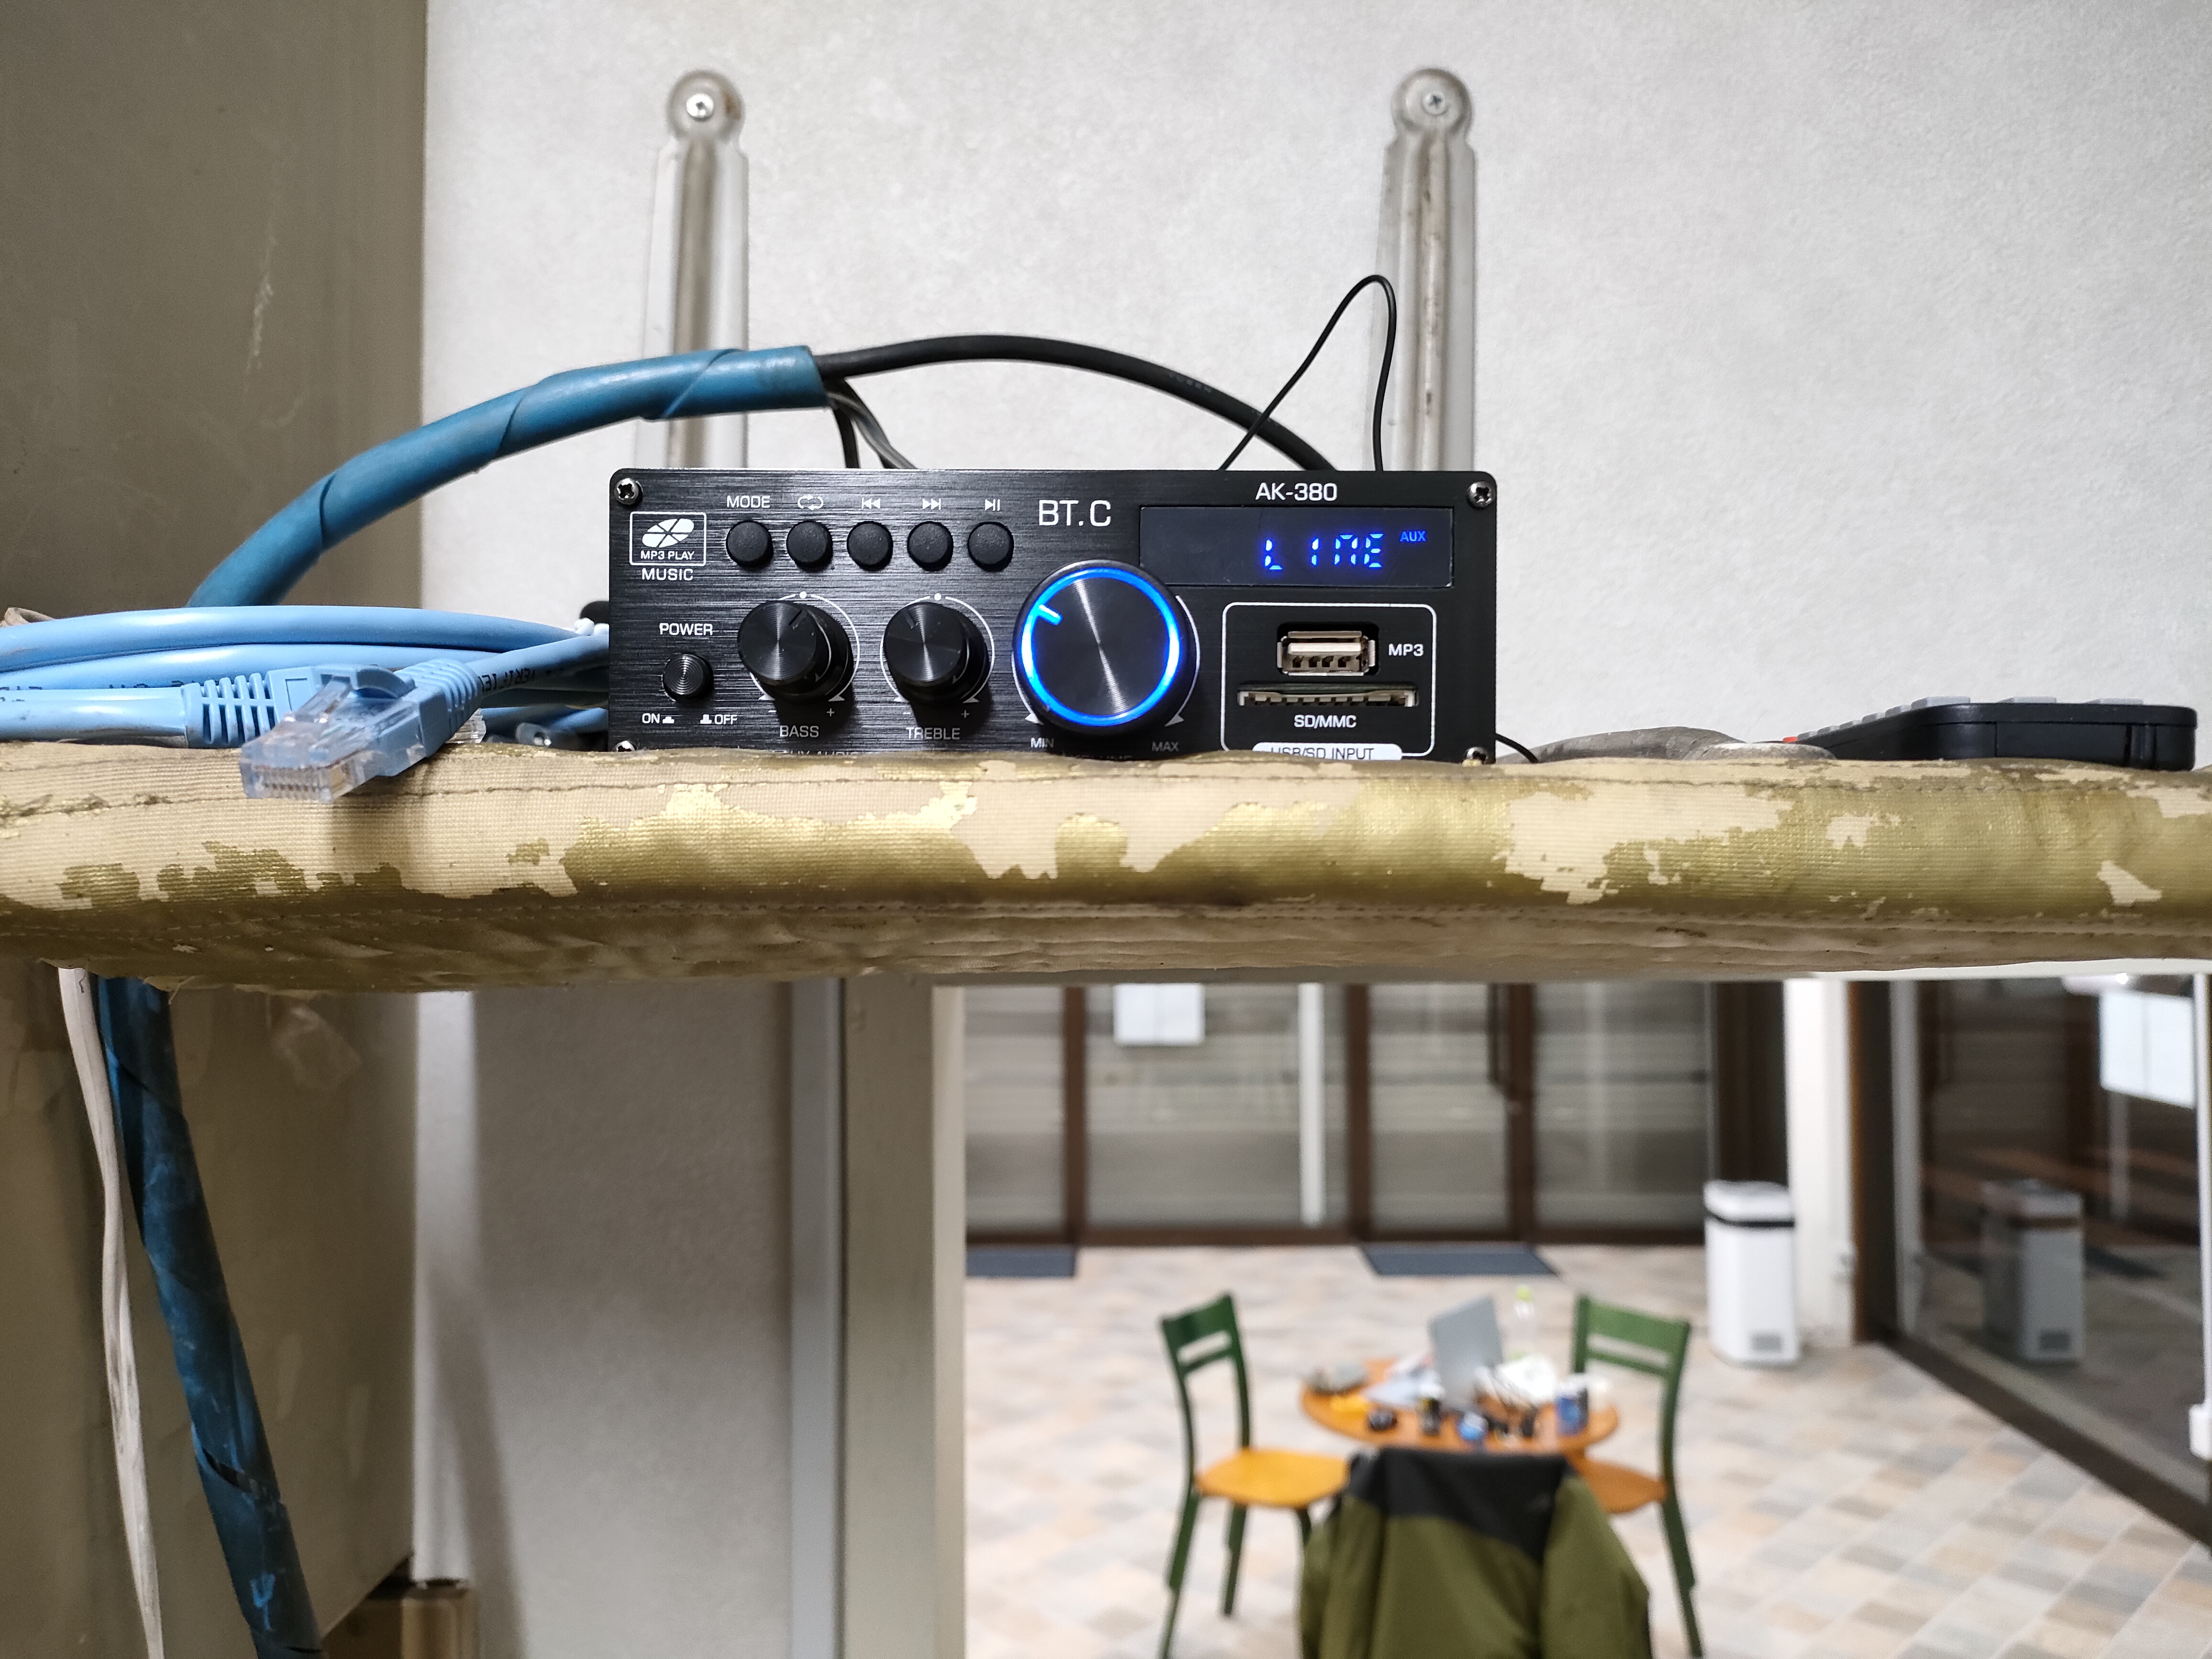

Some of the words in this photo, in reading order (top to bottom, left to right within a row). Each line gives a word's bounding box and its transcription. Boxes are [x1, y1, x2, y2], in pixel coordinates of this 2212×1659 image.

[1255, 483, 1338, 501] AK-380
[726, 496, 771, 509] MODE
[1038, 499, 1111, 527] BT.C
[1400, 531, 1427, 542] AUX
[640, 551, 665, 561] MP3
[667, 551, 695, 561] PLAY
[641, 568, 694, 581] MUSIC
[659, 623, 713, 636] POWER
[1388, 643, 1424, 656] MP3
[642, 713, 660, 724] ON
[714, 714, 738, 725] OFF
[1294, 715, 1357, 729] SD/MMC
[779, 725, 819, 738] BASS
[906, 727, 961, 740] TREBLE
[1030, 737, 1054, 748] MIN
[1151, 741, 1179, 752] MAX
[1332, 748, 1374, 760] INPUT
